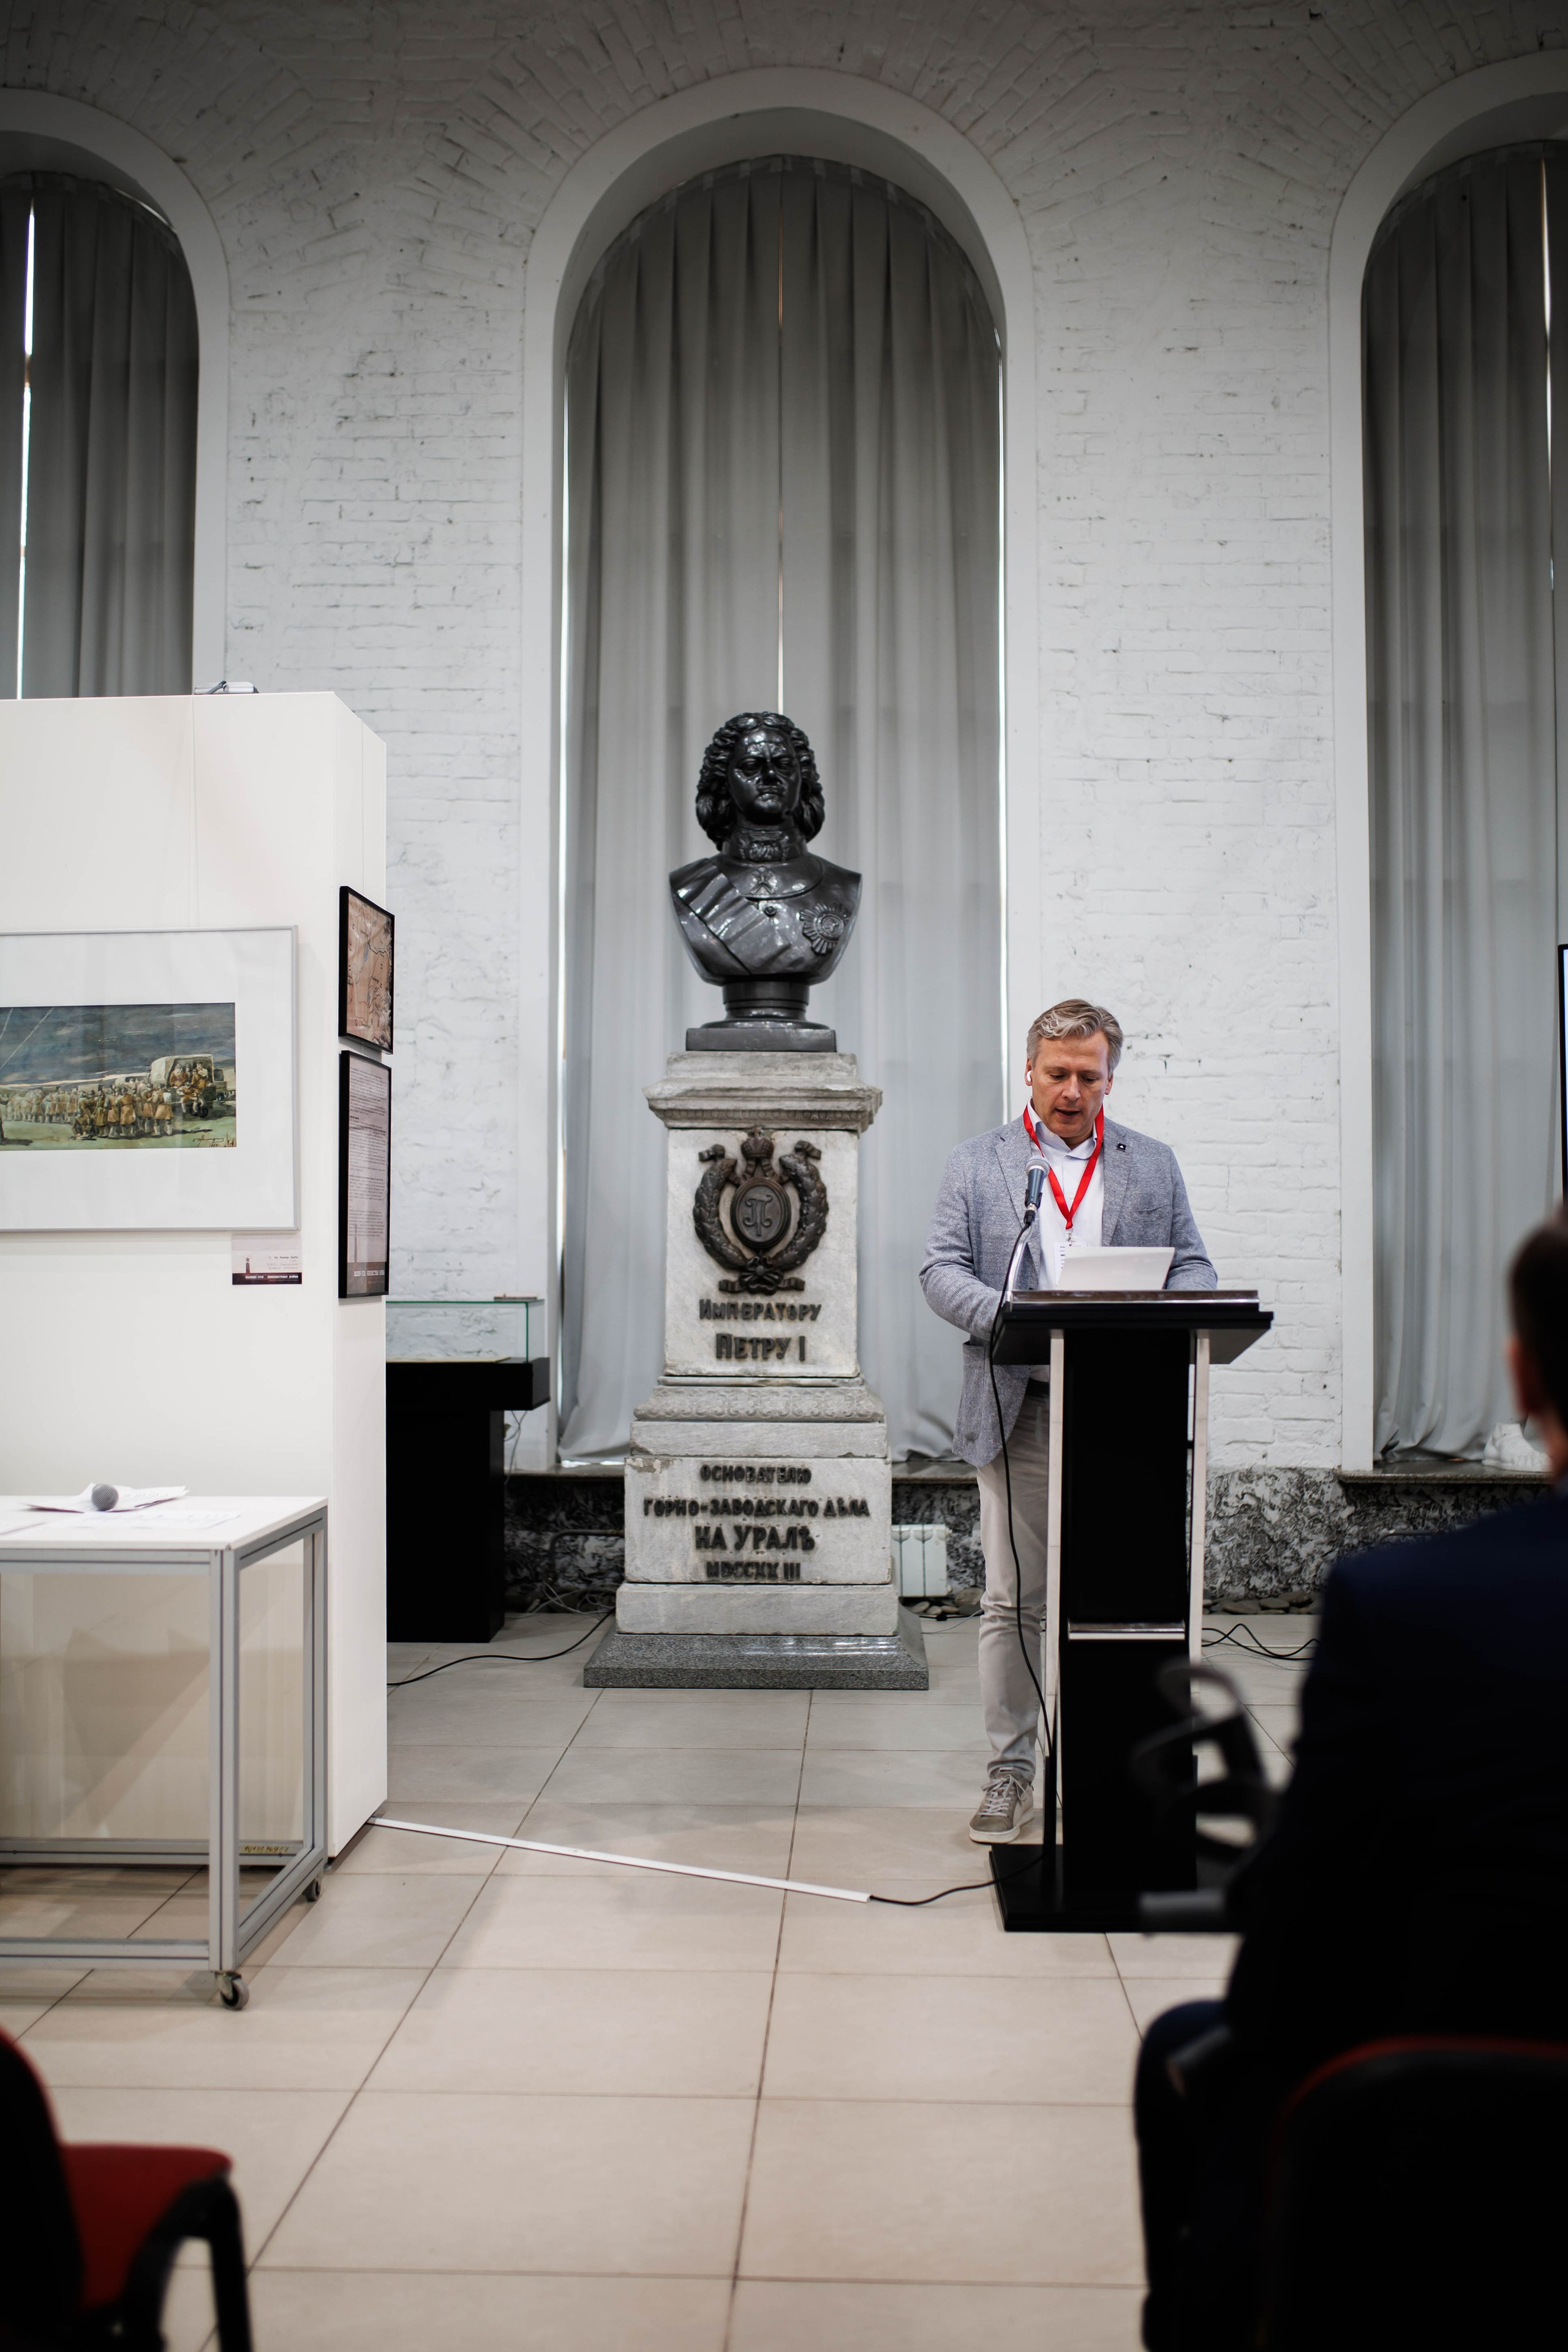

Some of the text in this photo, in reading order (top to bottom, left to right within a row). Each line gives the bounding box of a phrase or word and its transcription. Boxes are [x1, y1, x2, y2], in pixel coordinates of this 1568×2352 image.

[715, 1333, 805, 1361] ПЕТРУ I
[700, 1464, 812, 1484] ОСНОВАТЕЛЮ
[644, 1499, 819, 1517] ГОРНО-ЗАВОДСКАГО
[695, 1526, 727, 1550] НА
